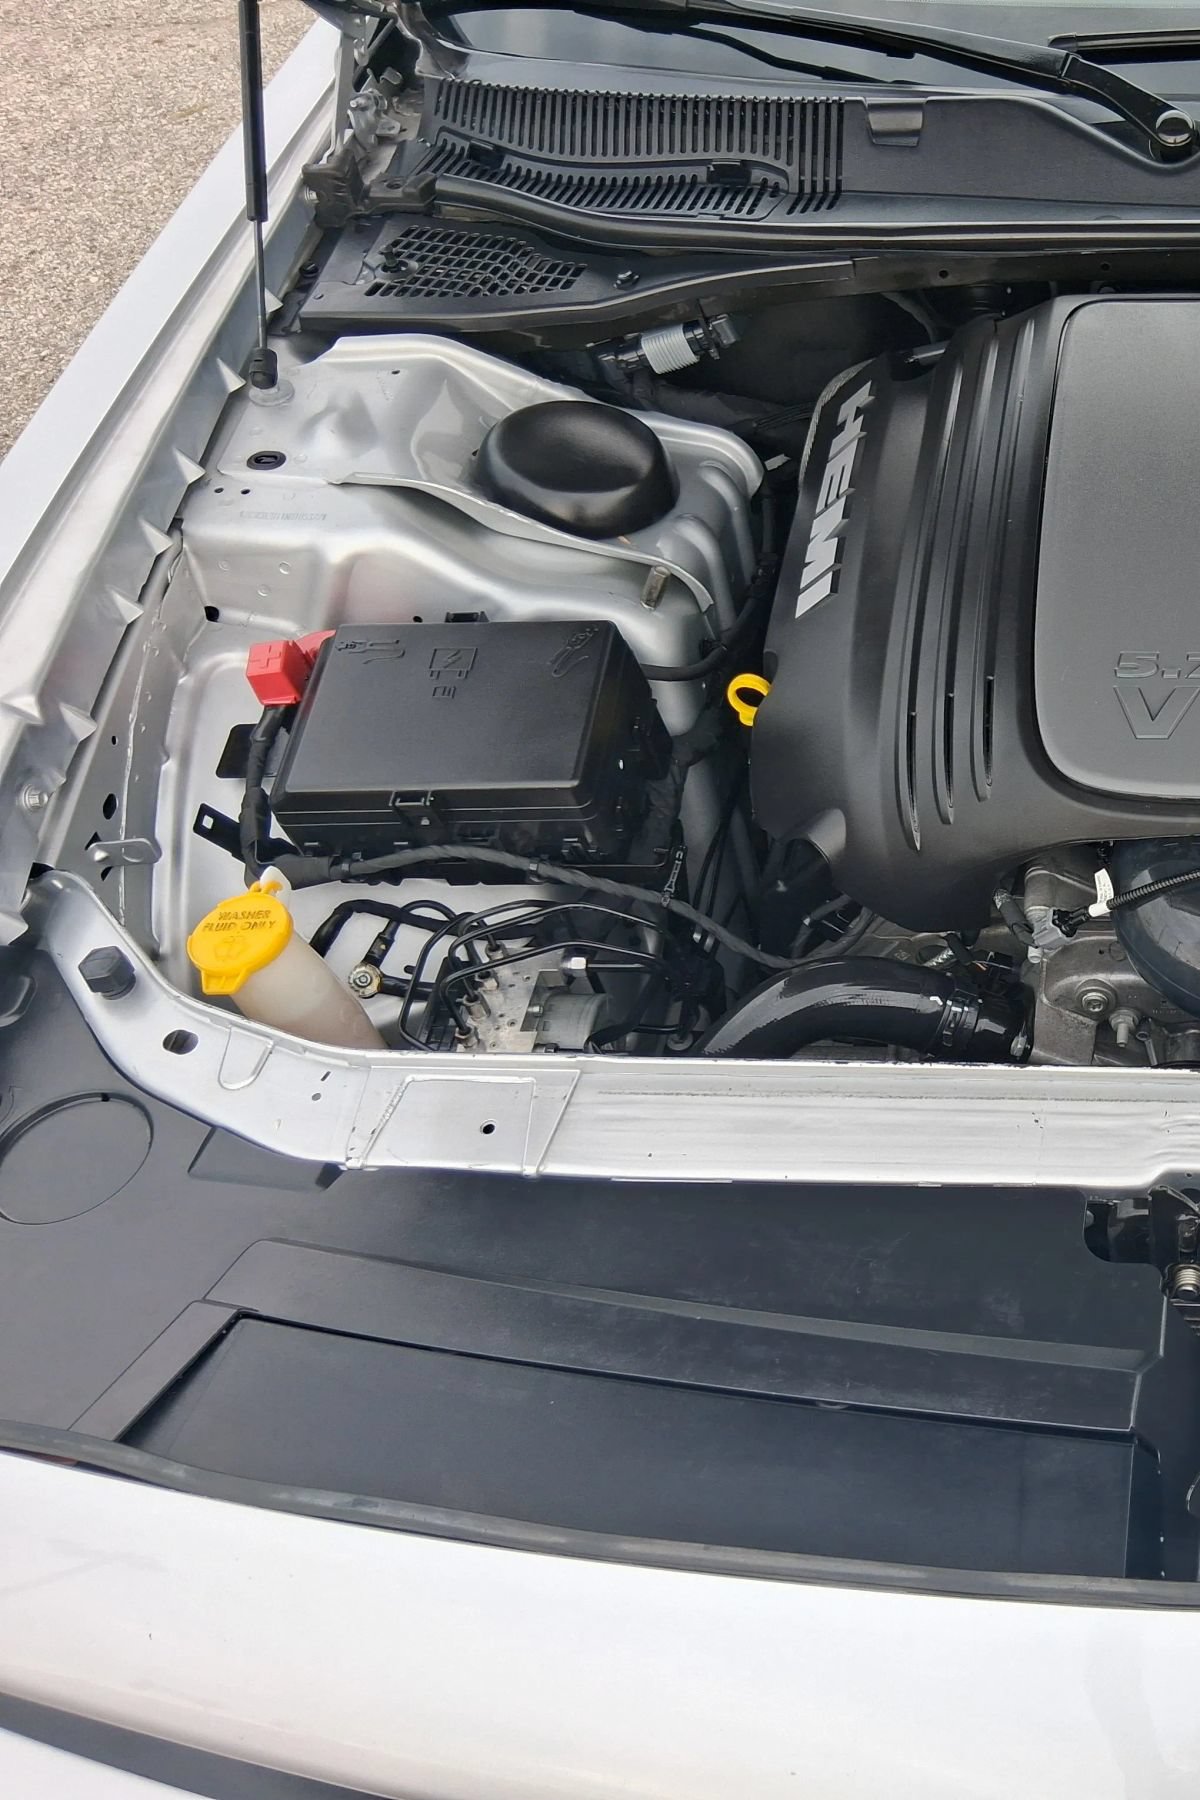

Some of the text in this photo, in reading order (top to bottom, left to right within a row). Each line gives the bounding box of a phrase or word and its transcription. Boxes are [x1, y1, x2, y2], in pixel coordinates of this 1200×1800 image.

[795, 380, 872, 619] HEMI
[218, 909, 271, 920] WASHER
[203, 922, 238, 932] FLUID
